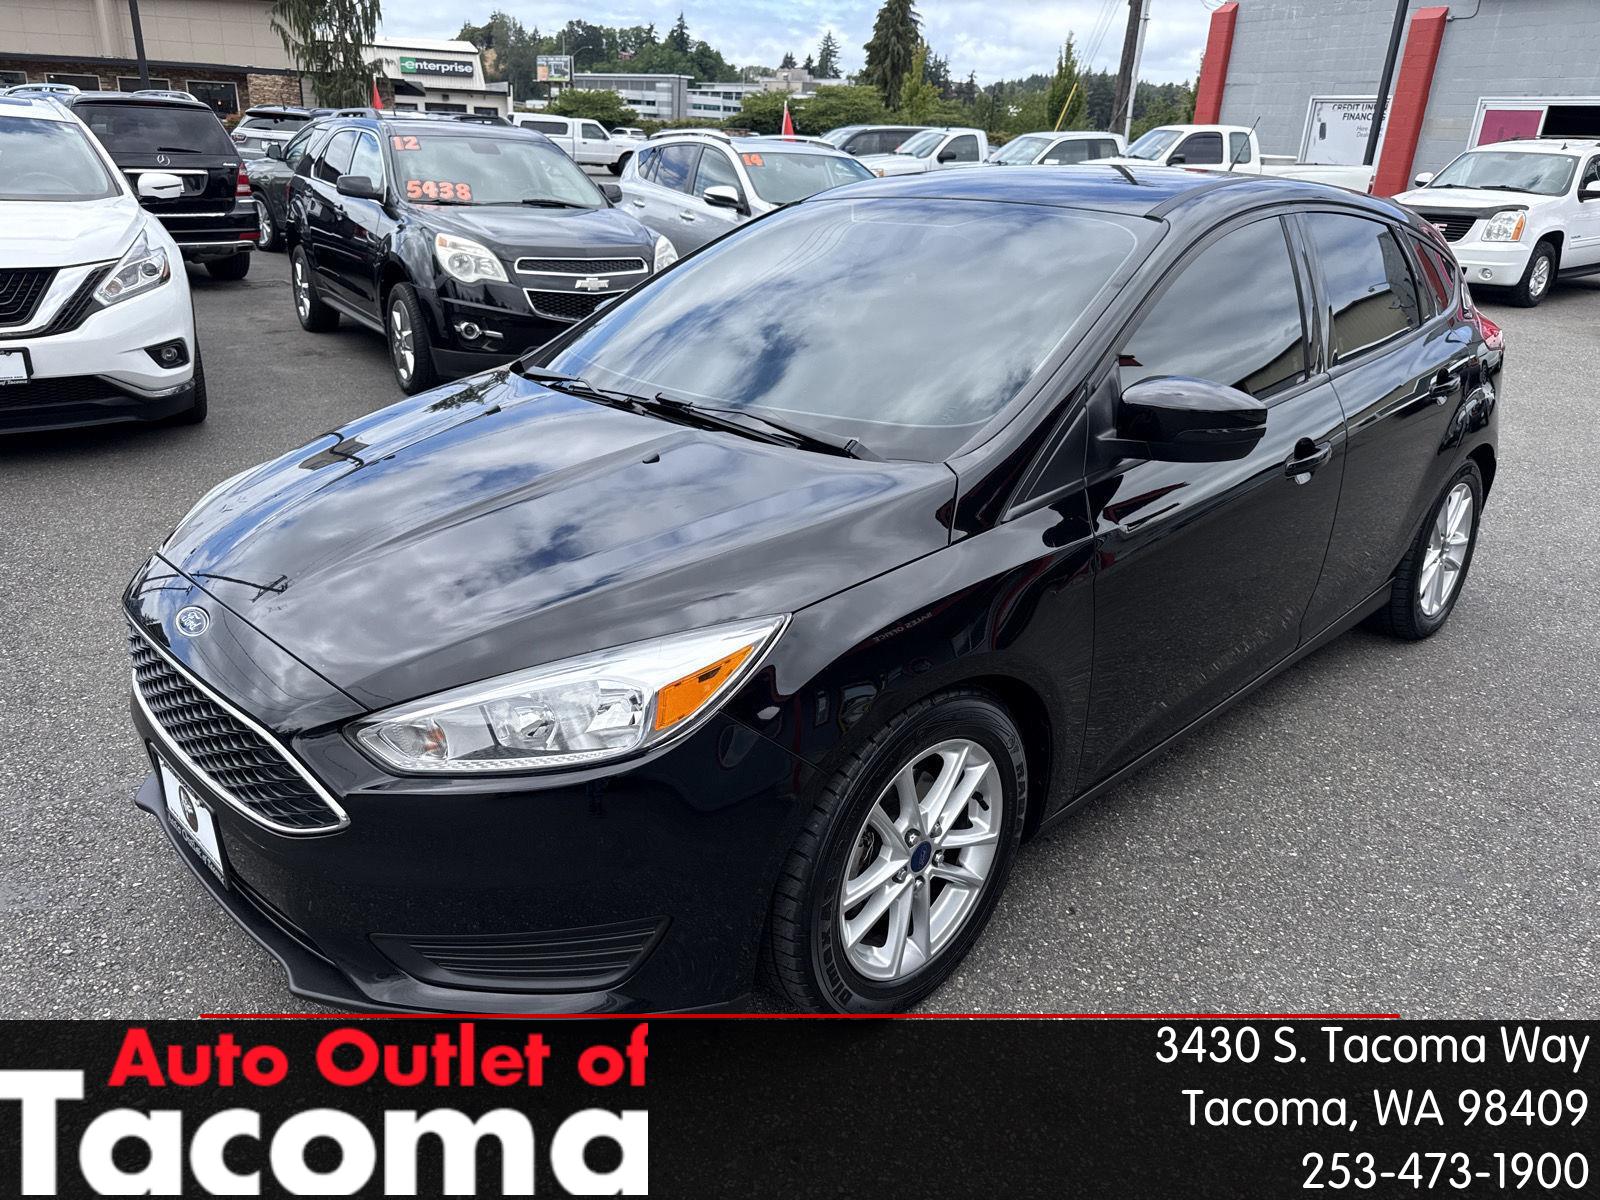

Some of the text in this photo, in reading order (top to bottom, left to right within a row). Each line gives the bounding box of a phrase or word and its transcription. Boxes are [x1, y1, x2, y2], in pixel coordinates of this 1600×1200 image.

[401, 60, 473, 73] enterprise
[393, 135, 421, 151] 12
[742, 153, 764, 166] 14
[406, 180, 472, 201] 5438
[180, 610, 204, 632] Ford
